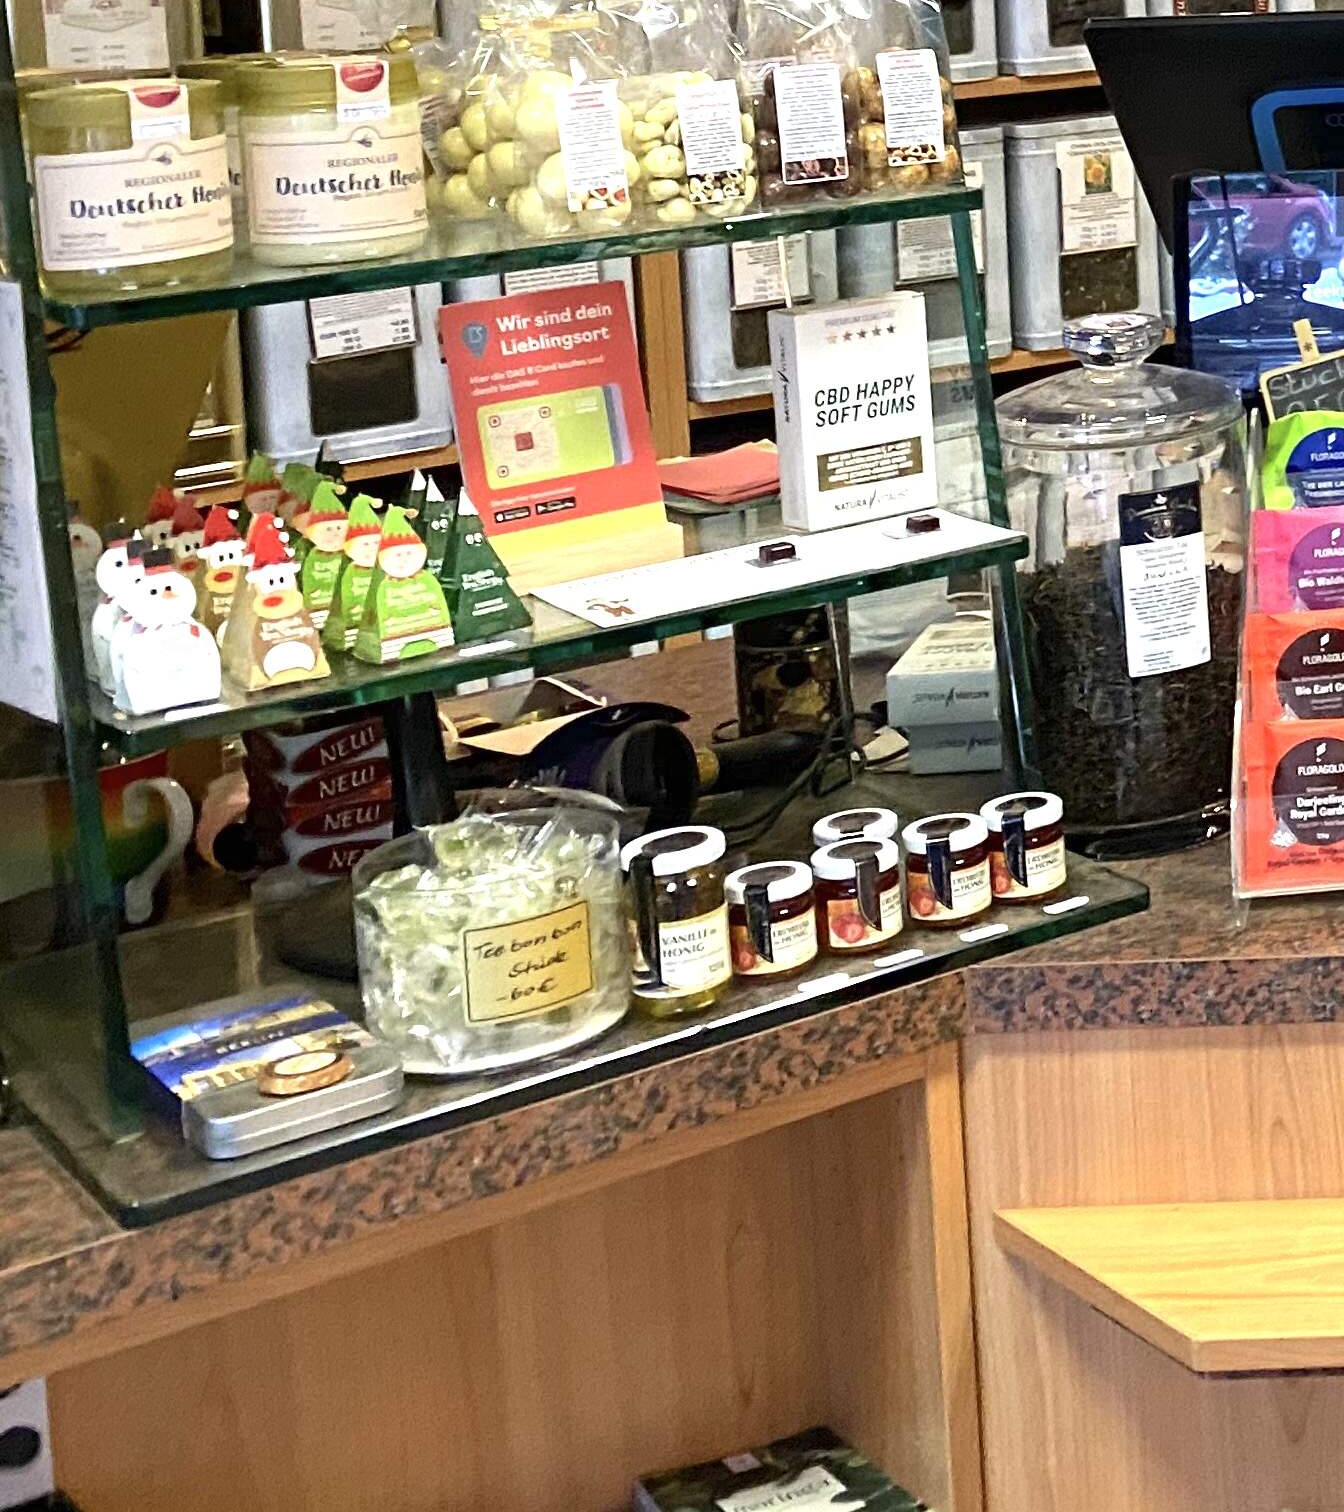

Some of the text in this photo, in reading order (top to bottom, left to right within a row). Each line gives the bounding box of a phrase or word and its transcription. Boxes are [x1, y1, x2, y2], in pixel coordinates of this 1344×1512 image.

[326, 153, 399, 169] REGIONALER
[124, 168, 202, 189] REGIONALER
[275, 175, 382, 196] Deutscher
[69, 192, 184, 220] Deutscher
[496, 303, 613, 332] Wir sind dein
[501, 326, 610, 357] Lieblingsort
[814, 374, 916, 407] CBD HAPPY
[815, 395, 916, 428] SOFT GUMS
[834, 499, 867, 511] NATURA
[1295, 684, 1313, 696] Bio
[1313, 683, 1334, 695] Earl
[1289, 806, 1318, 821] Royal
[662, 943, 705, 959] HONIG
